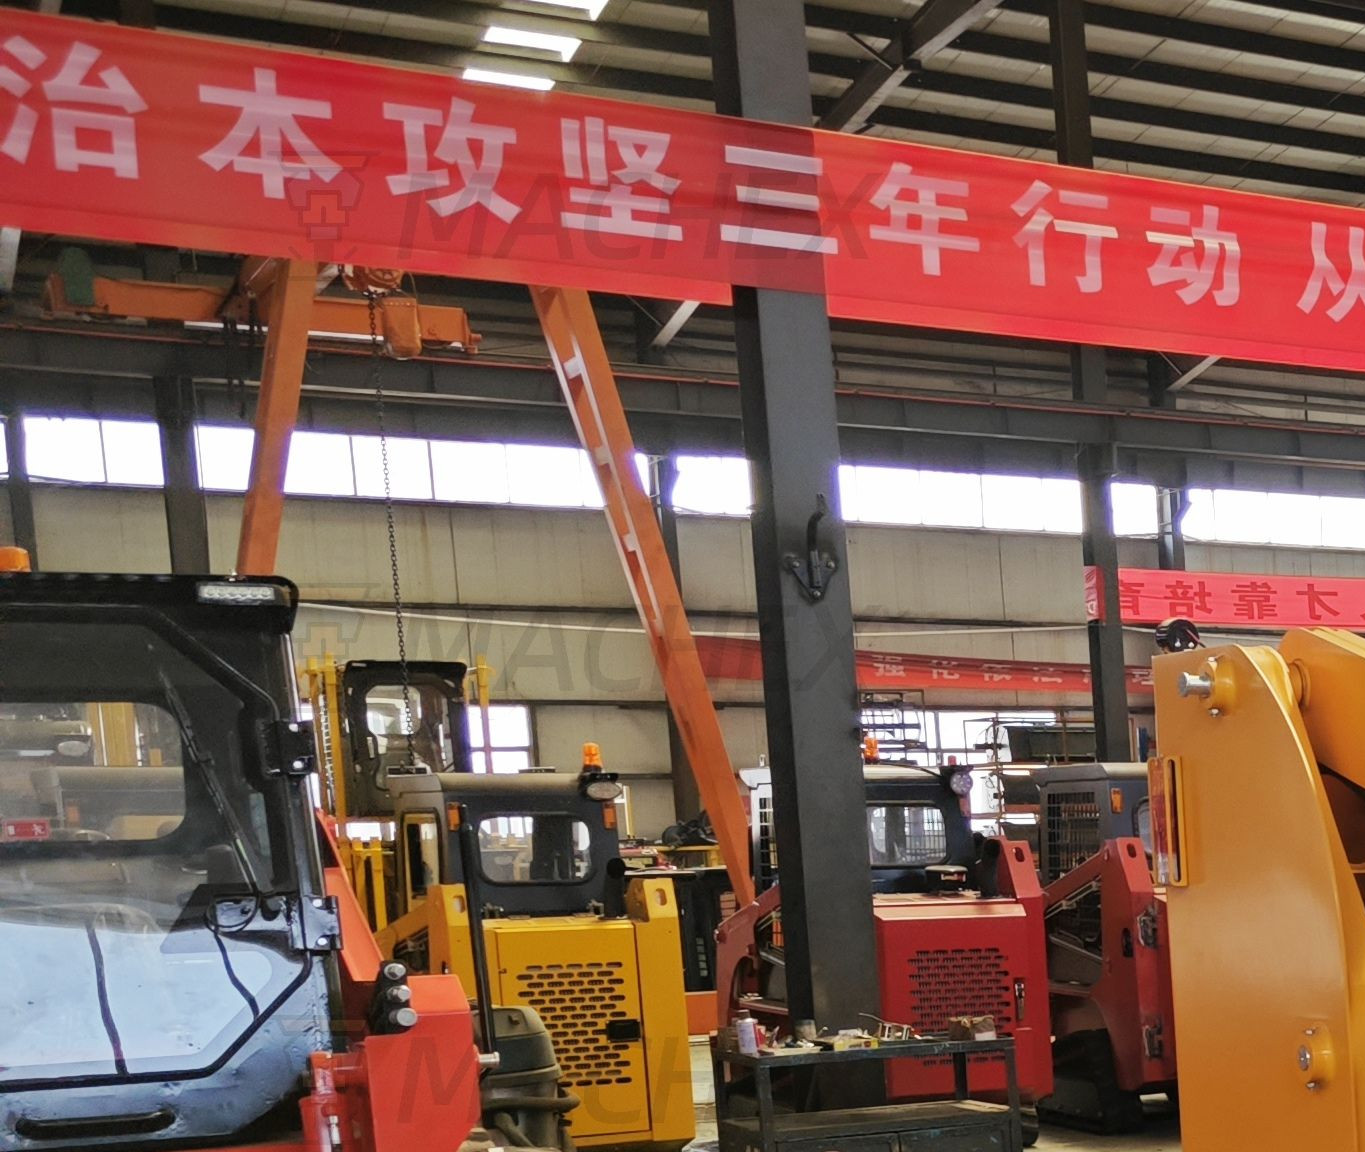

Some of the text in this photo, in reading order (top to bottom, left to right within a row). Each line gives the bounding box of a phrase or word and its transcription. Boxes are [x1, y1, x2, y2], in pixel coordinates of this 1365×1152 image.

[0, 35, 1242, 308] 治本攻坚三年行动
